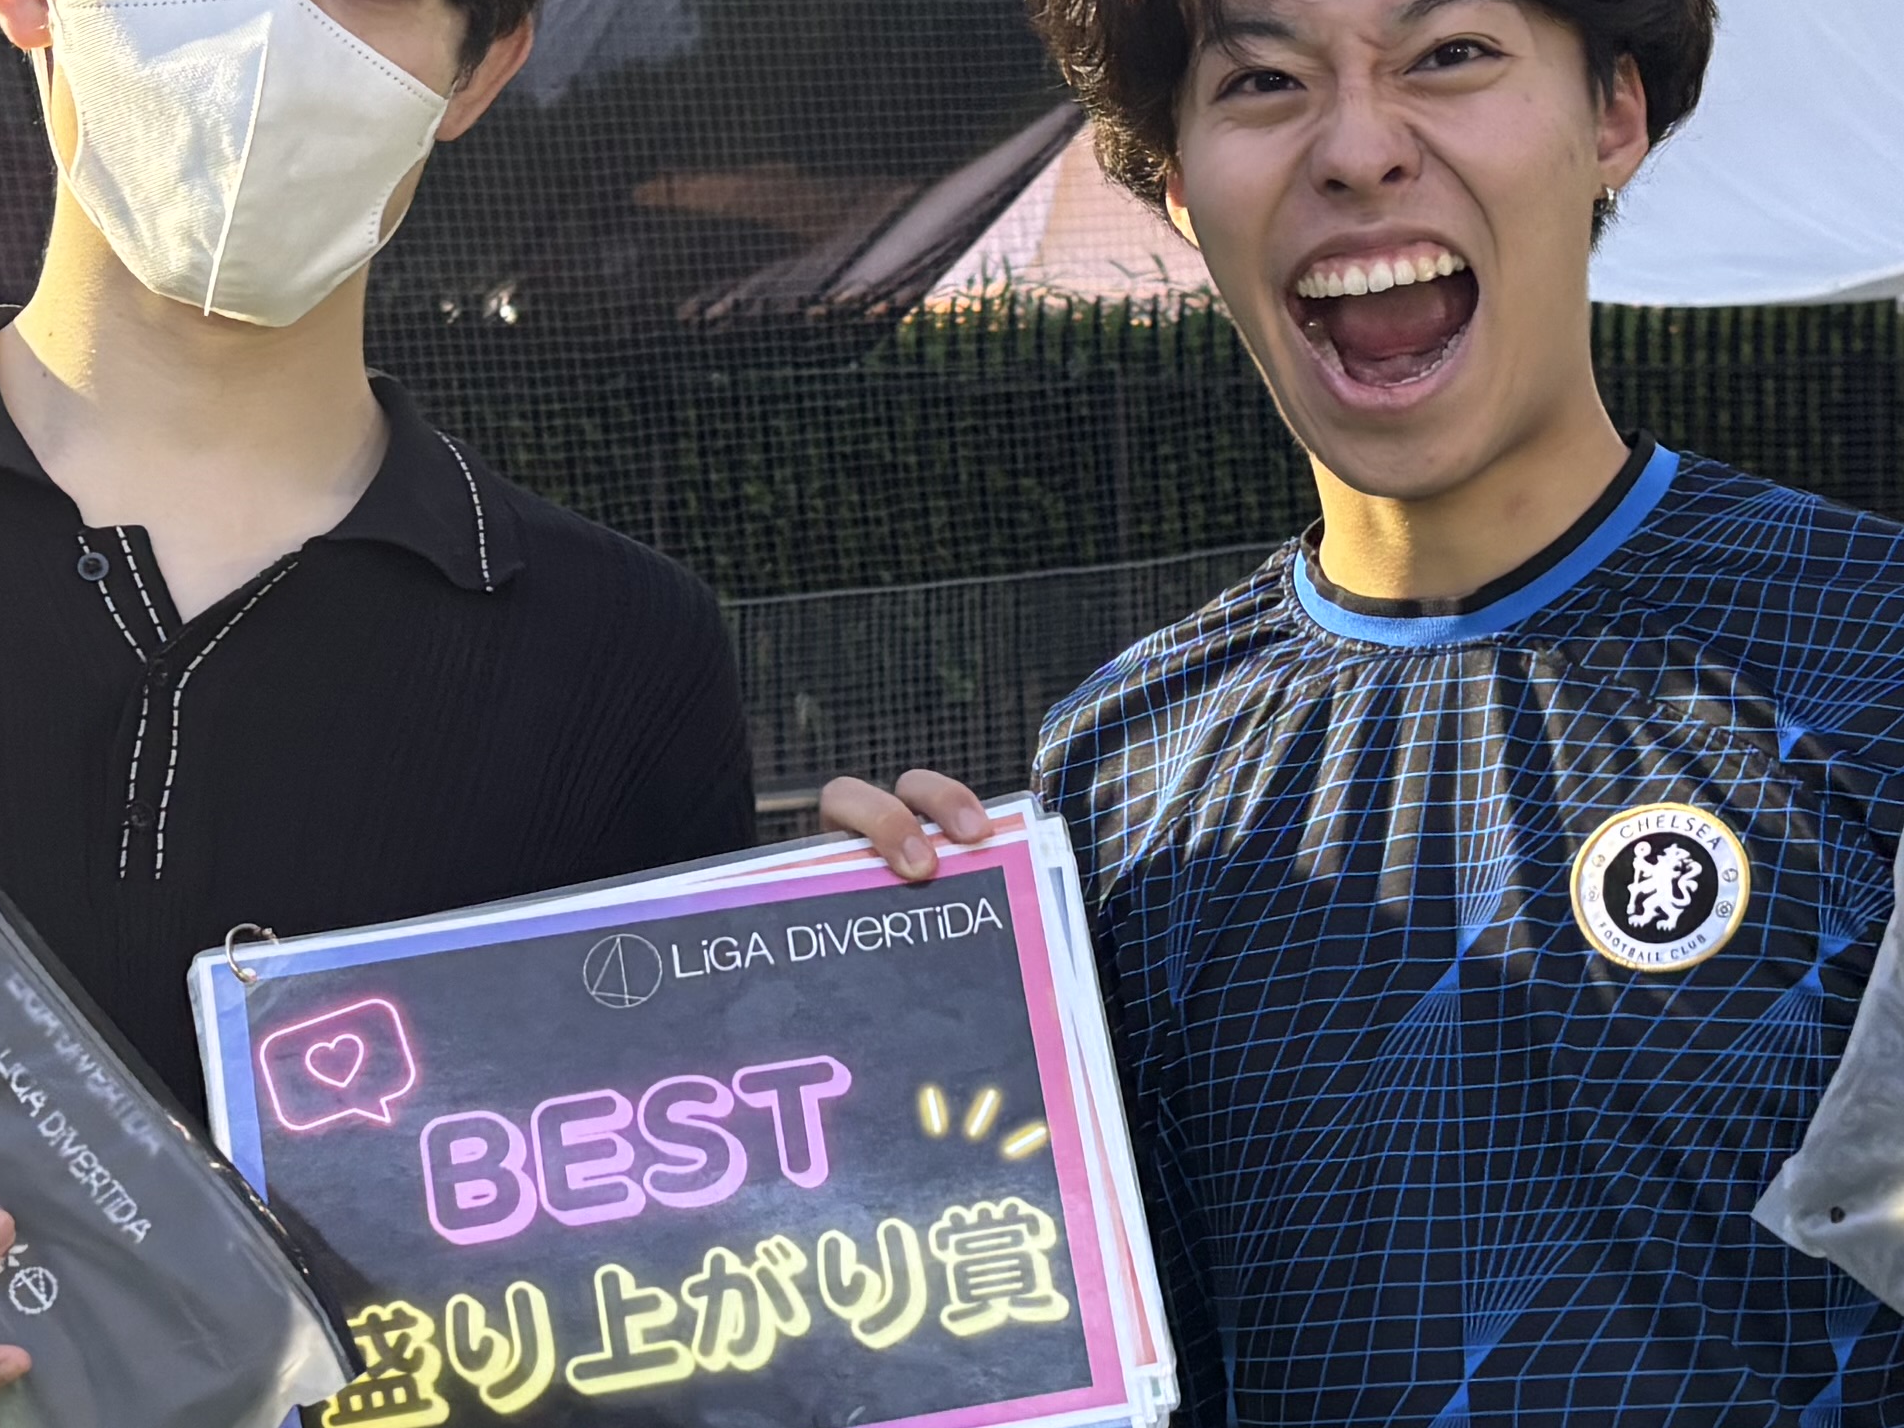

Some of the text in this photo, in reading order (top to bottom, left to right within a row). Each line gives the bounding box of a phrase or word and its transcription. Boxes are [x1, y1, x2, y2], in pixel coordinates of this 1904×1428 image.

[1619, 814, 1723, 851] CHELSEA
[1669, 933, 1708, 960] CLUB
[419, 1054, 853, 1246] BEST
